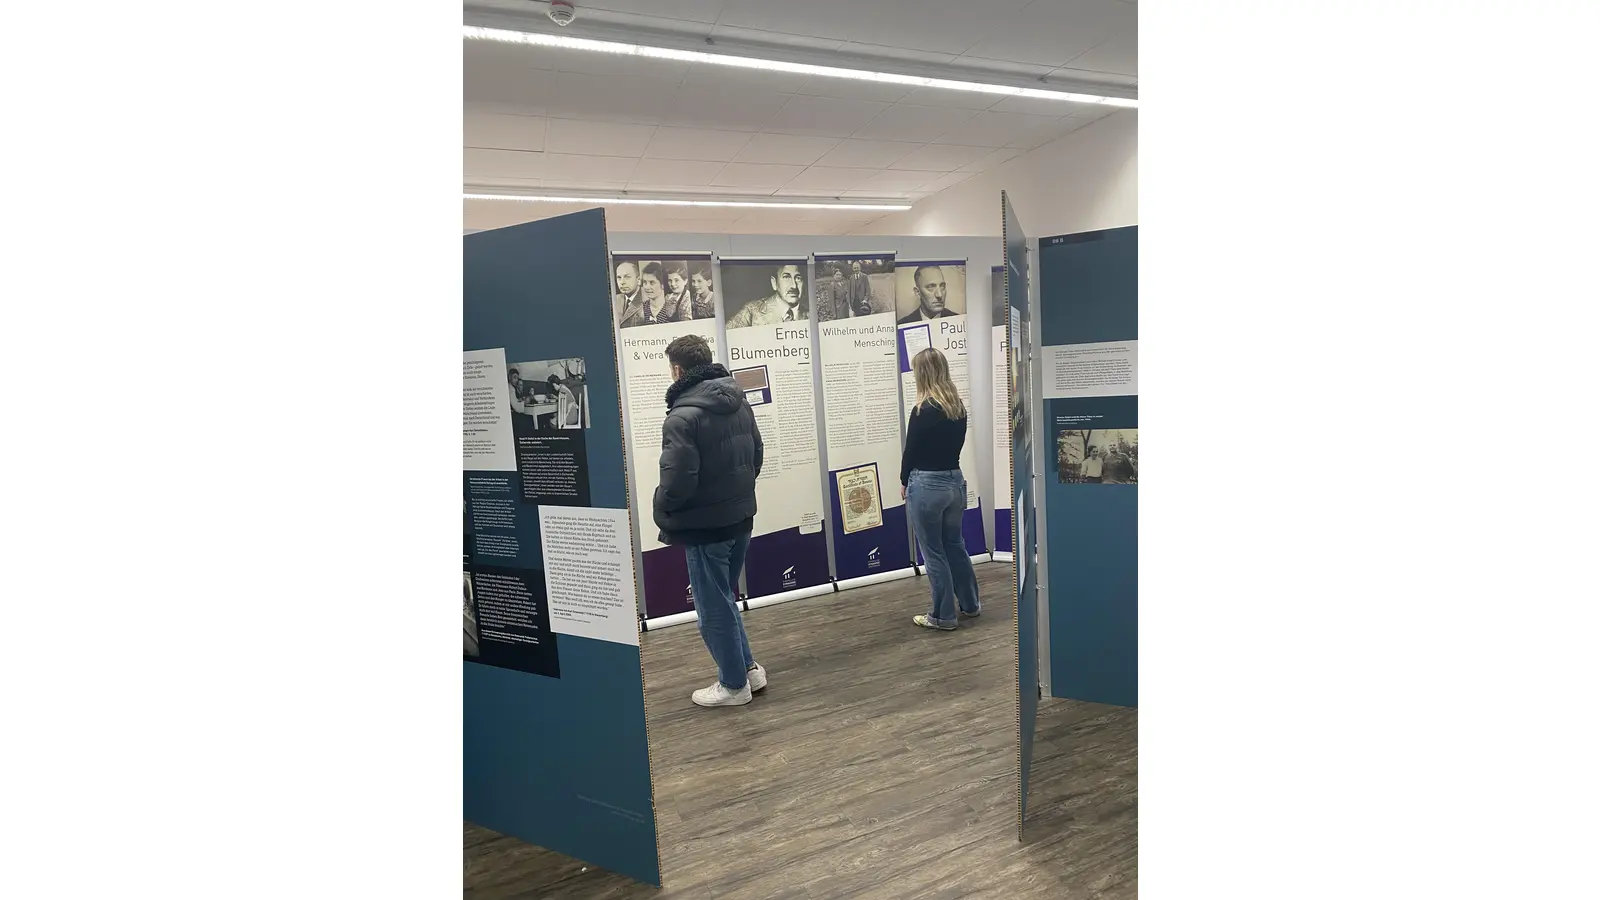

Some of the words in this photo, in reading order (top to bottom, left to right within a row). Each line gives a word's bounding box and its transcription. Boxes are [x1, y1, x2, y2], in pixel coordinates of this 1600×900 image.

[776, 327, 808, 339] Ernst
[823, 327, 857, 336] Wilhelm
[859, 326, 874, 334] und
[876, 325, 894, 333] Anna
[941, 321, 966, 334] Paul
[854, 338, 895, 348] Mensching
[943, 337, 967, 350] Jost
[633, 351, 641, 361] &
[643, 352, 664, 360] Vera
[731, 345, 810, 360] Blumenberg
